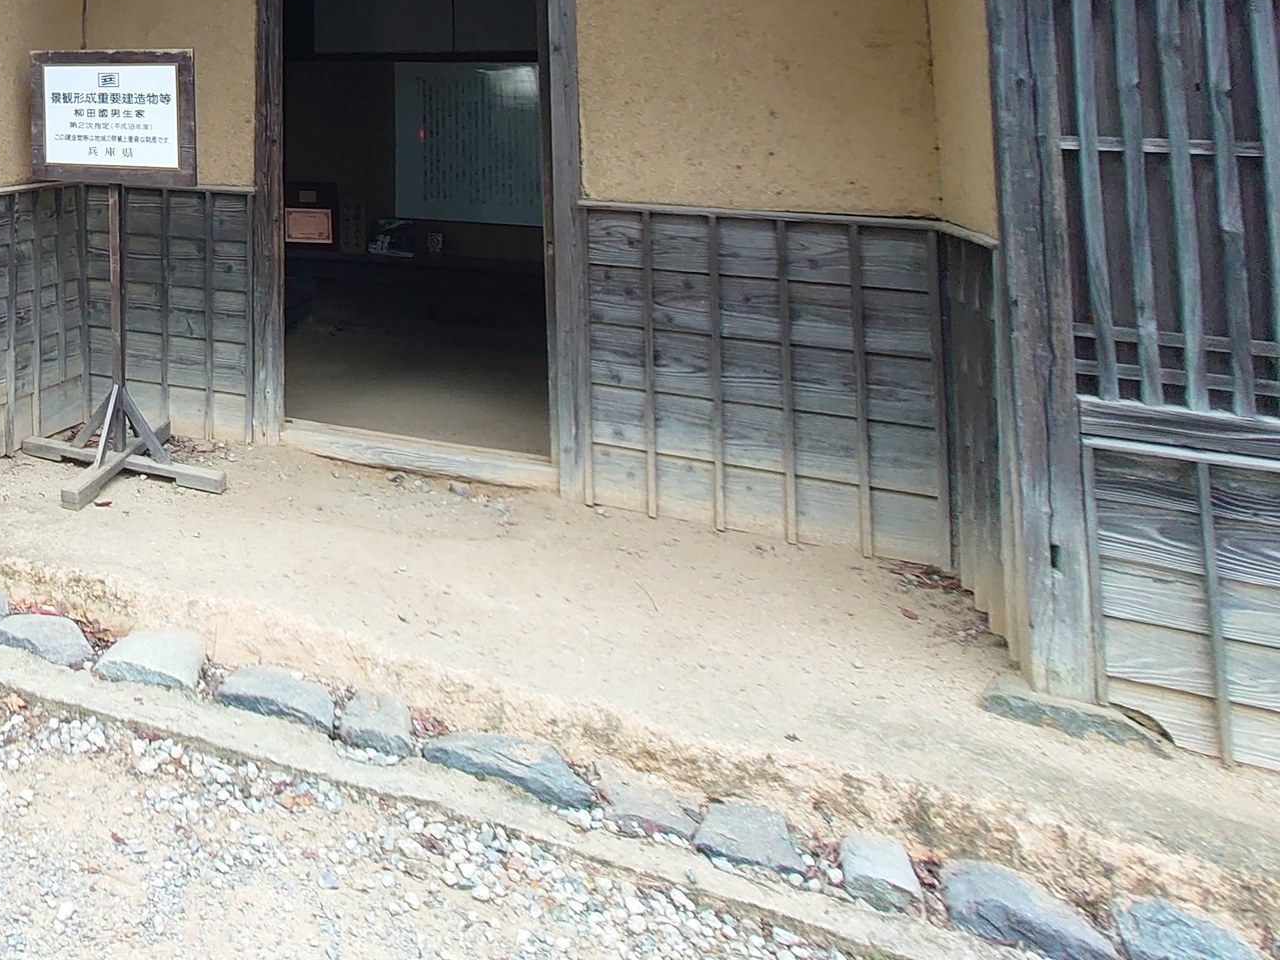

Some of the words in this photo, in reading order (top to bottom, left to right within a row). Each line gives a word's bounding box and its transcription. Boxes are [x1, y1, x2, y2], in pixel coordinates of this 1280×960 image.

[51, 92, 172, 105] 景観形成重要建造物等
[74, 109, 145, 119] 柳田國男生家
[88, 146, 134, 158] 兵庫県
